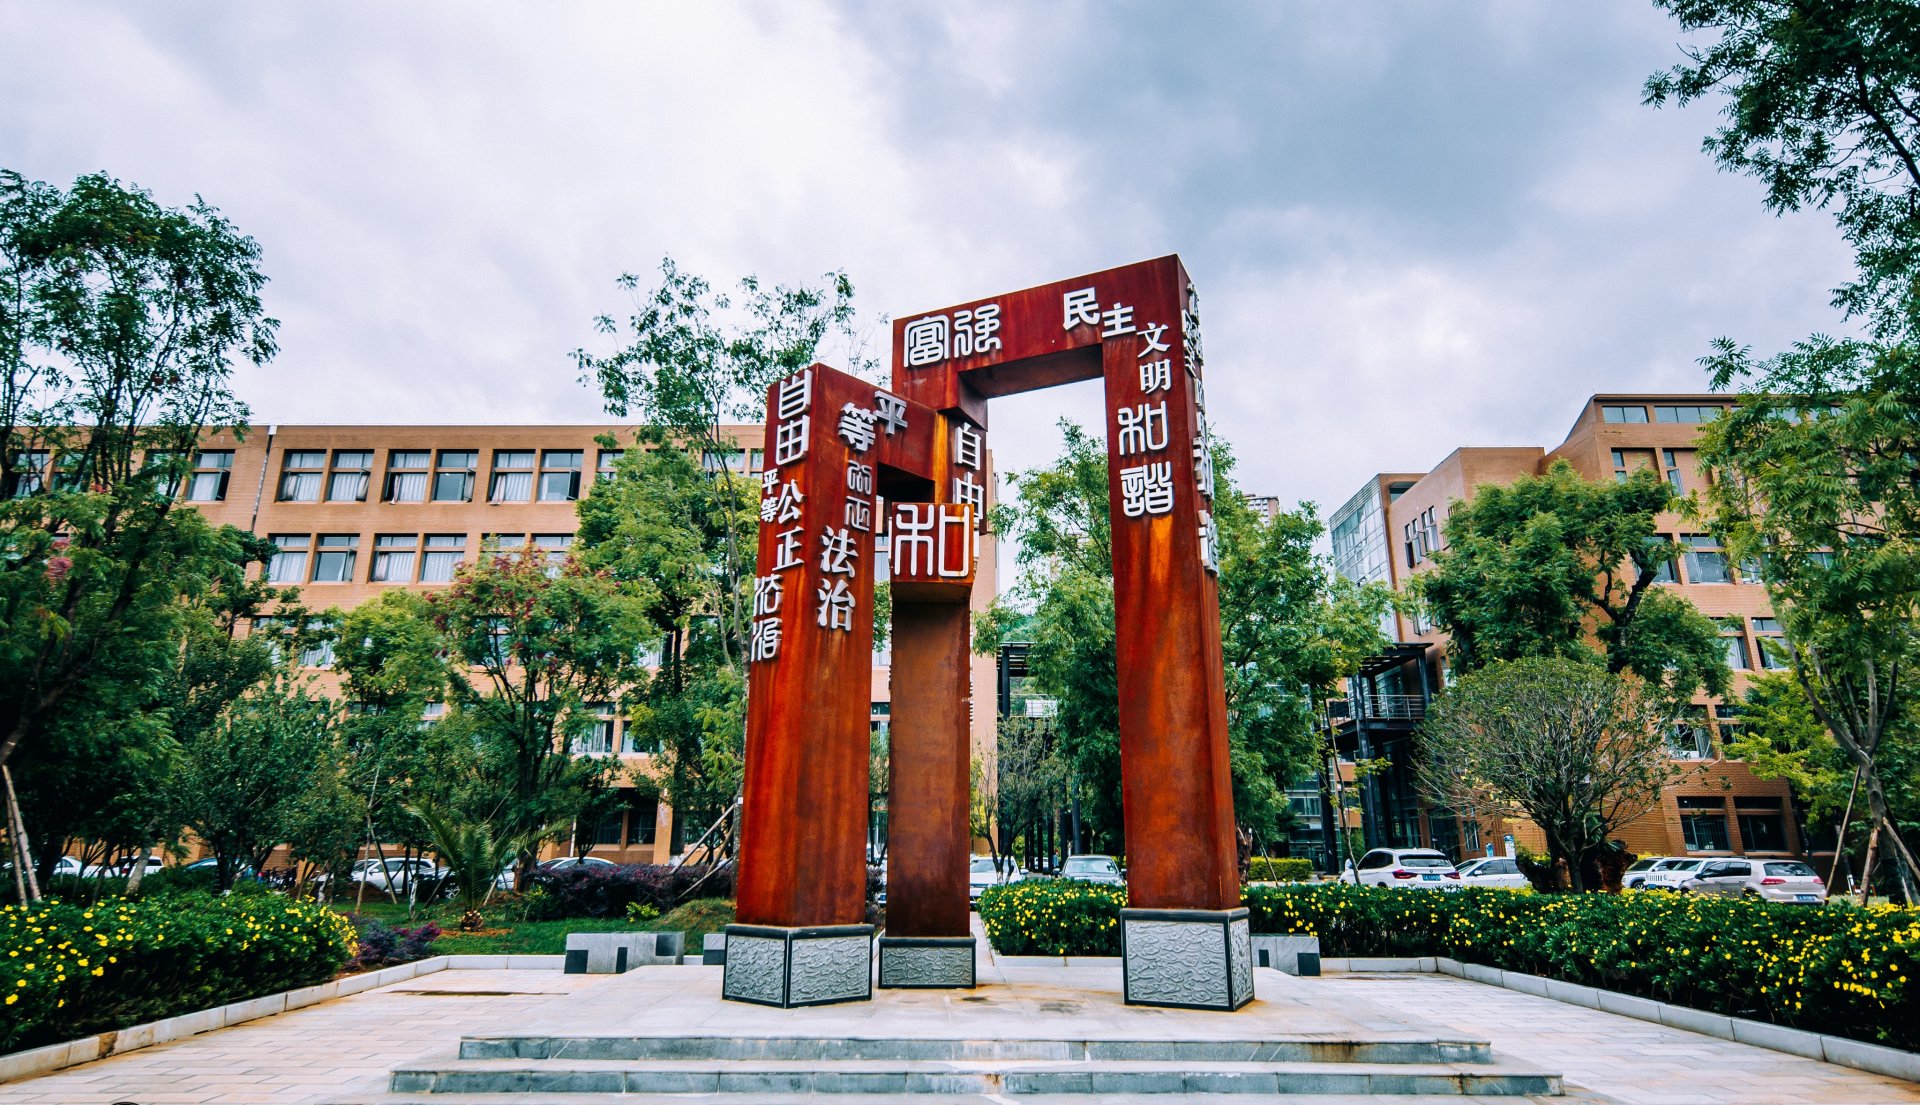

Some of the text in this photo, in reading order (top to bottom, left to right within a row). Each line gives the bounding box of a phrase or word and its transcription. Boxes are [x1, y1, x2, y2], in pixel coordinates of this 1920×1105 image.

[904, 303, 1003, 368] 富强
[1063, 287, 1137, 338] 民主
[1136, 322, 1172, 394] 文明
[776, 369, 813, 466] 自由
[761, 467, 781, 524] 平等
[952, 421, 985, 521] 自由
[772, 478, 806, 572] 公正
[894, 503, 970, 577] 和
[816, 525, 860, 632] 法治
